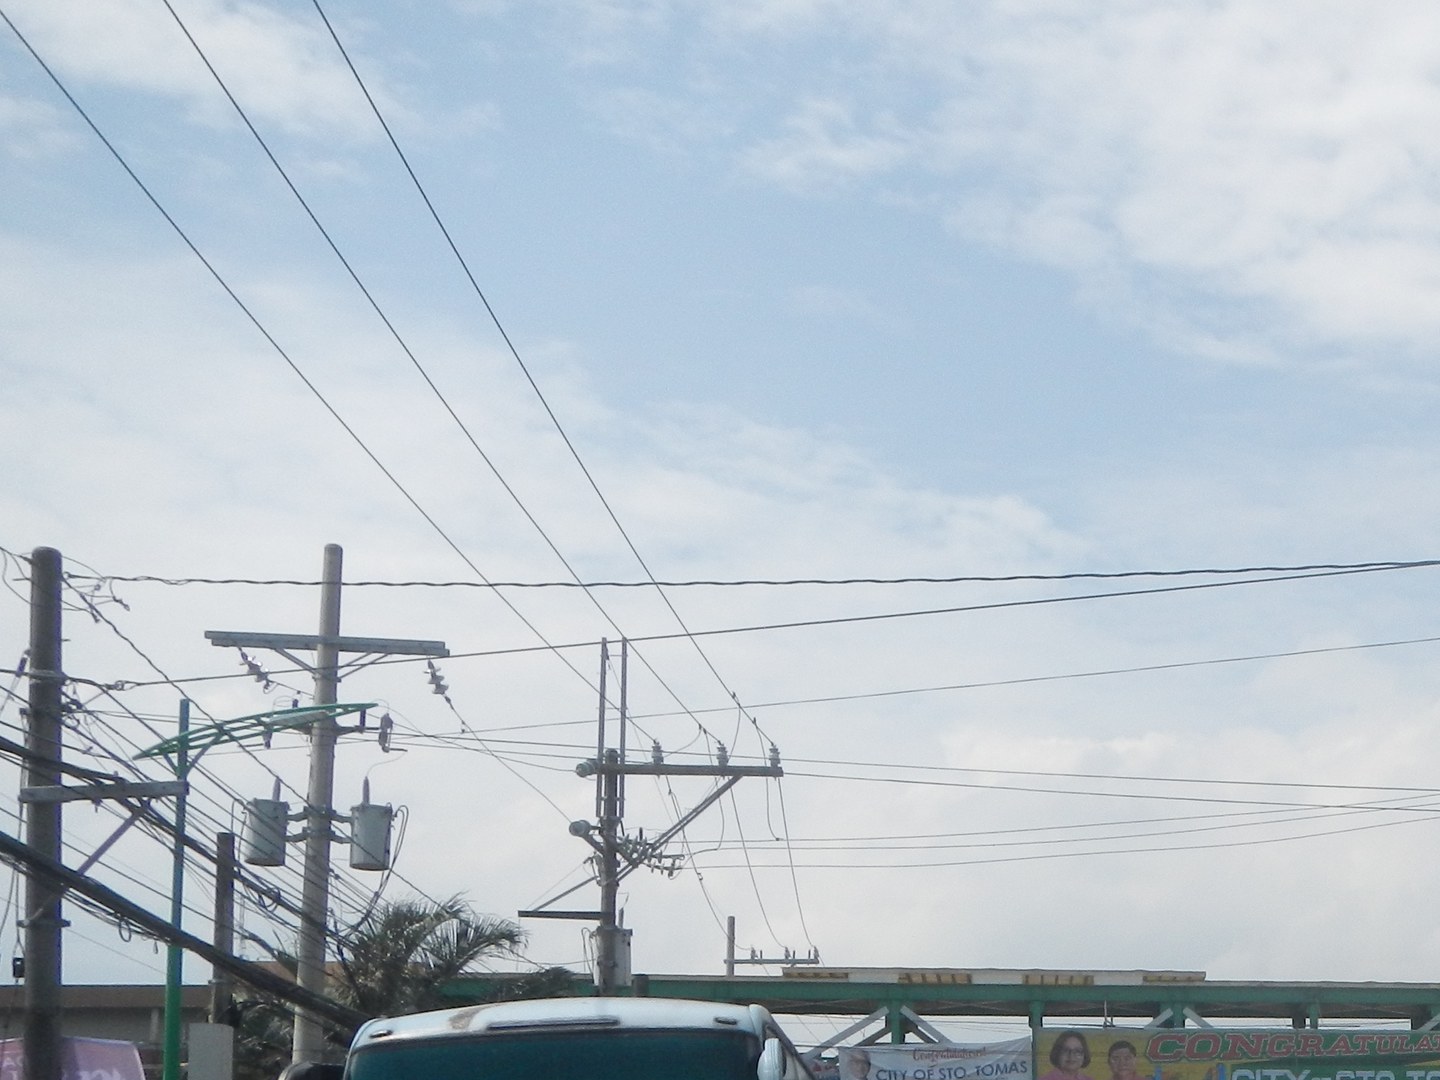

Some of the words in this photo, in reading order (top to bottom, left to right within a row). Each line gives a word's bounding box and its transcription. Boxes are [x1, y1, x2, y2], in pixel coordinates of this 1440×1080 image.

[913, 1069, 934, 1080] OF
[939, 1066, 970, 1080] STO.
[975, 1061, 1028, 1077] TOMAS
